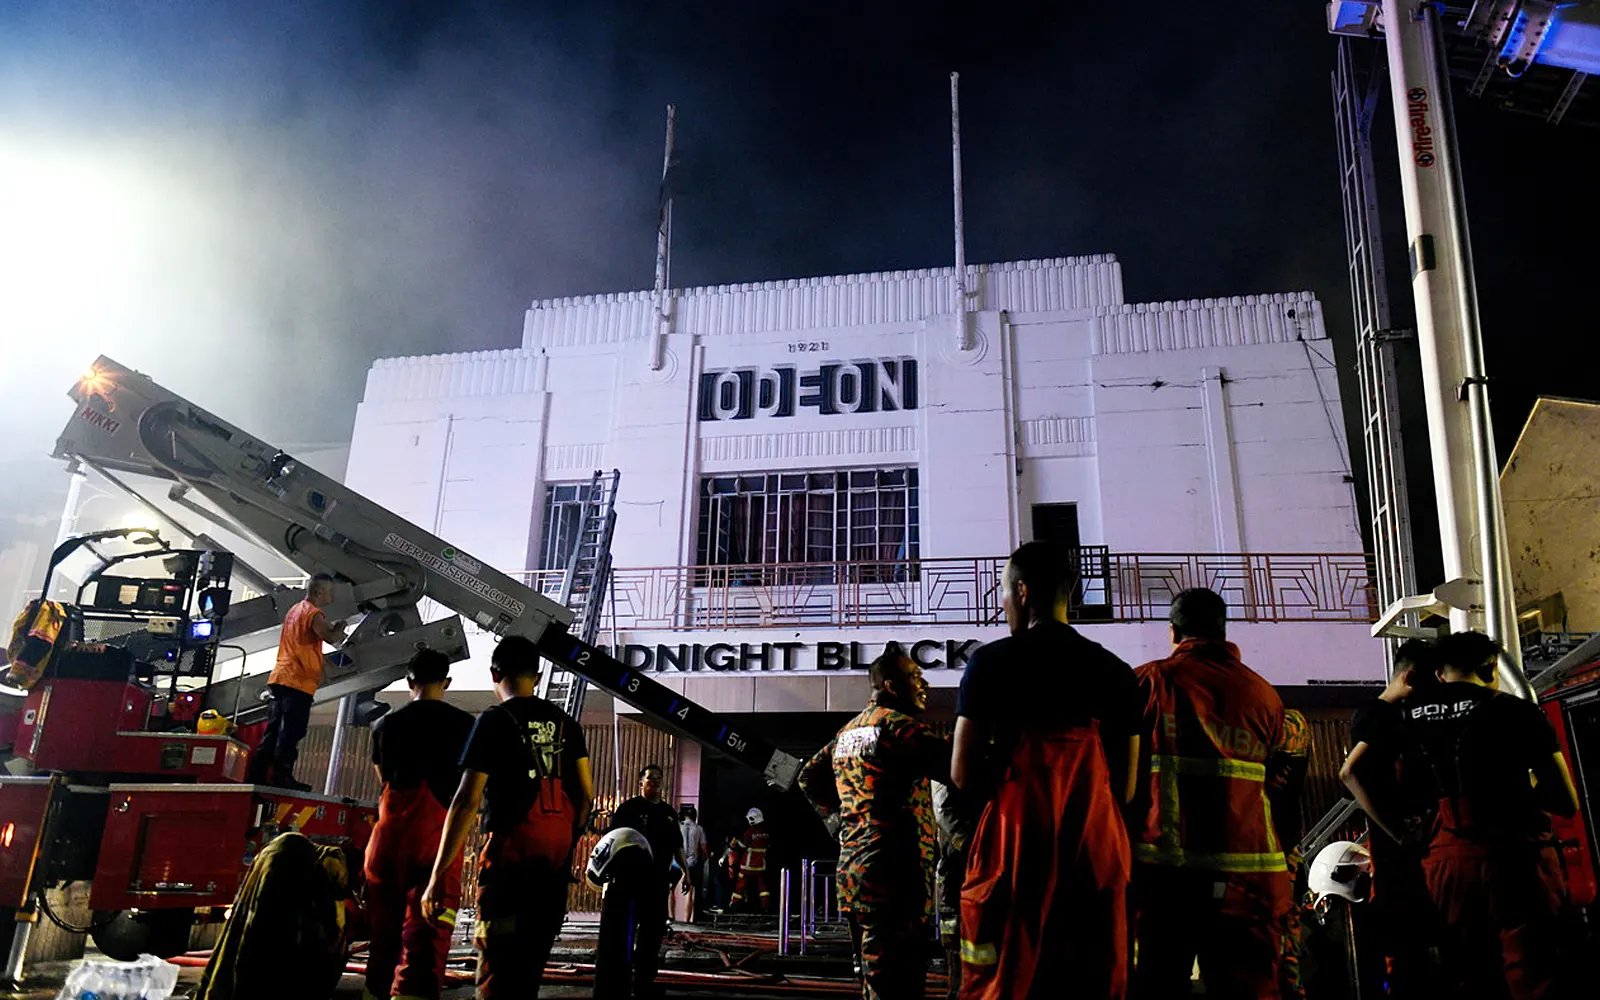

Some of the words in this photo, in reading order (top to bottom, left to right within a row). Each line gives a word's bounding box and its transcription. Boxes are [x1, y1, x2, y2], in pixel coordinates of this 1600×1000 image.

[788, 341, 829, 353] 1921
[703, 357, 916, 421] ODEON
[81, 406, 120, 434] NIKKI
[447, 565, 489, 593] SECRET
[490, 588, 524, 614] CODES
[577, 651, 590, 666] 2
[628, 678, 640, 693] 3
[676, 706, 690, 721] 4
[726, 732, 747, 752] 5M
[1163, 712, 1267, 759] BMBA
